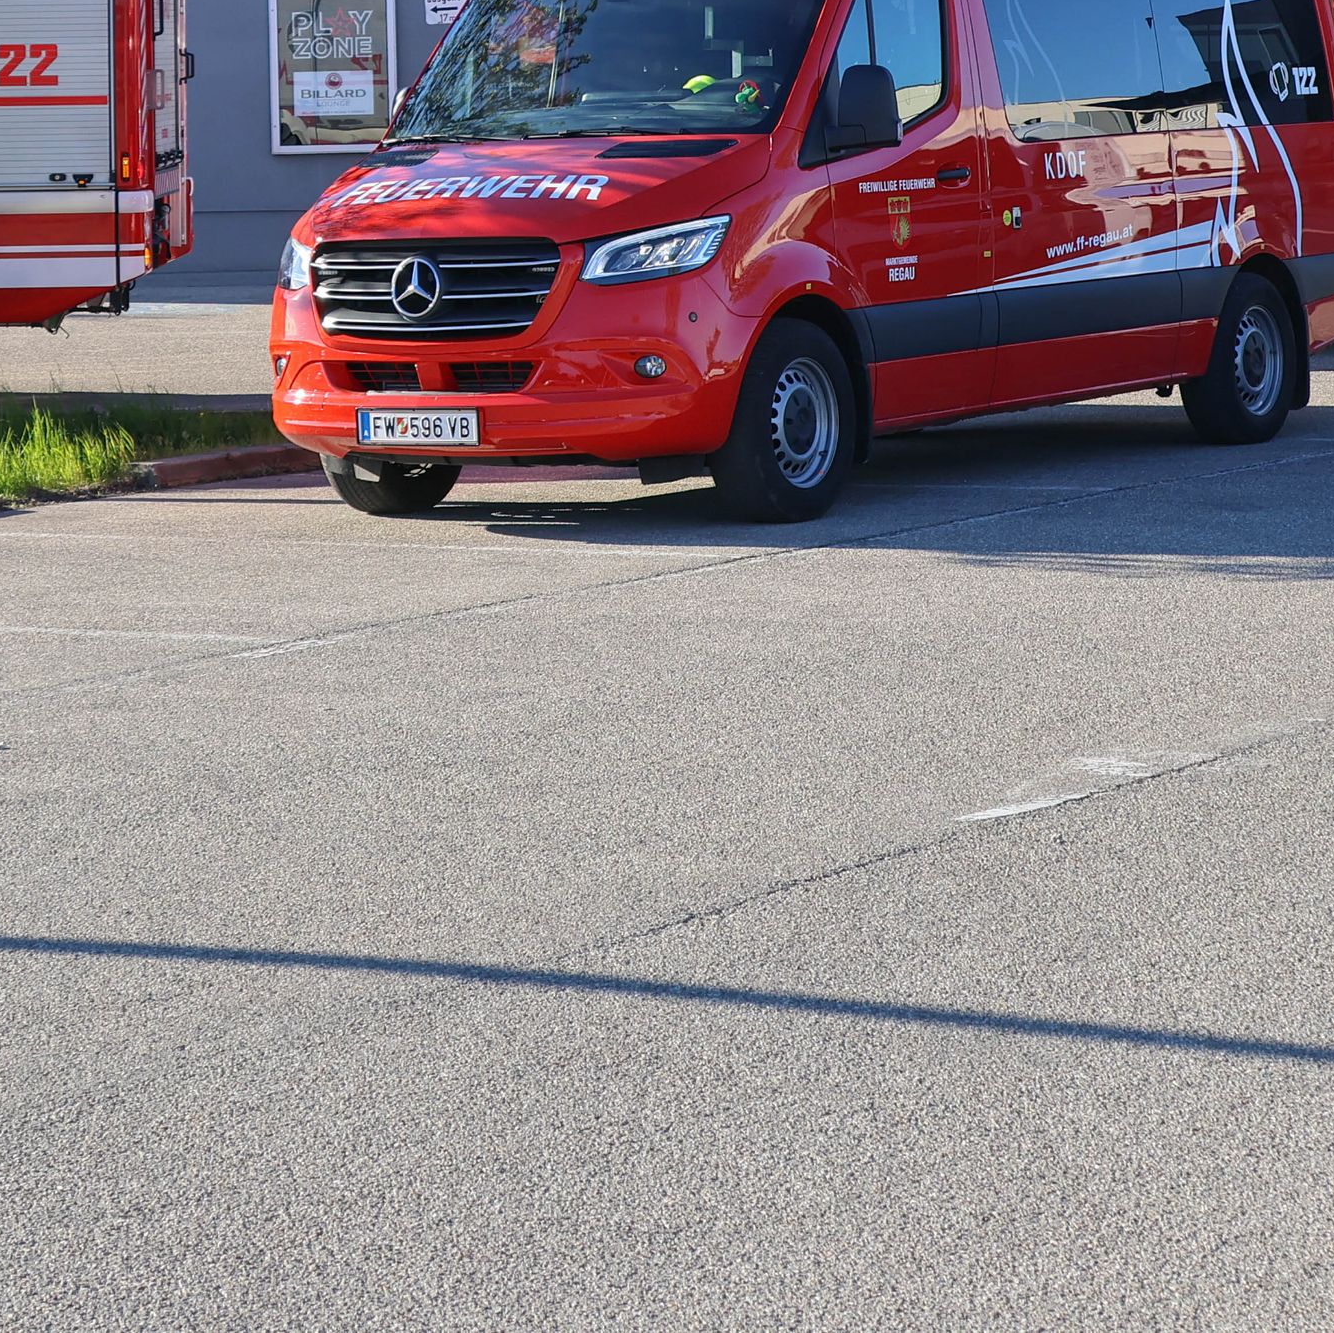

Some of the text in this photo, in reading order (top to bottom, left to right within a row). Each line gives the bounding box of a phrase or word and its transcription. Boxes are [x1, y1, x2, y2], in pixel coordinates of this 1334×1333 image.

[292, 37, 372, 59] ZONE
[1292, 66, 1319, 96] 122
[301, 88, 366, 99] BILLARD
[1044, 150, 1087, 180] KDOF
[329, 174, 610, 208] FEUERWEHR
[858, 178, 936, 194] FREIWILLIGE FEUERWEHR
[1046, 223, 1134, 259] www.ff-regau.at
[889, 266, 916, 282] REGAU
[372, 416, 396, 438] FW
[409, 417, 443, 438] 596
[447, 417, 470, 438] VB
